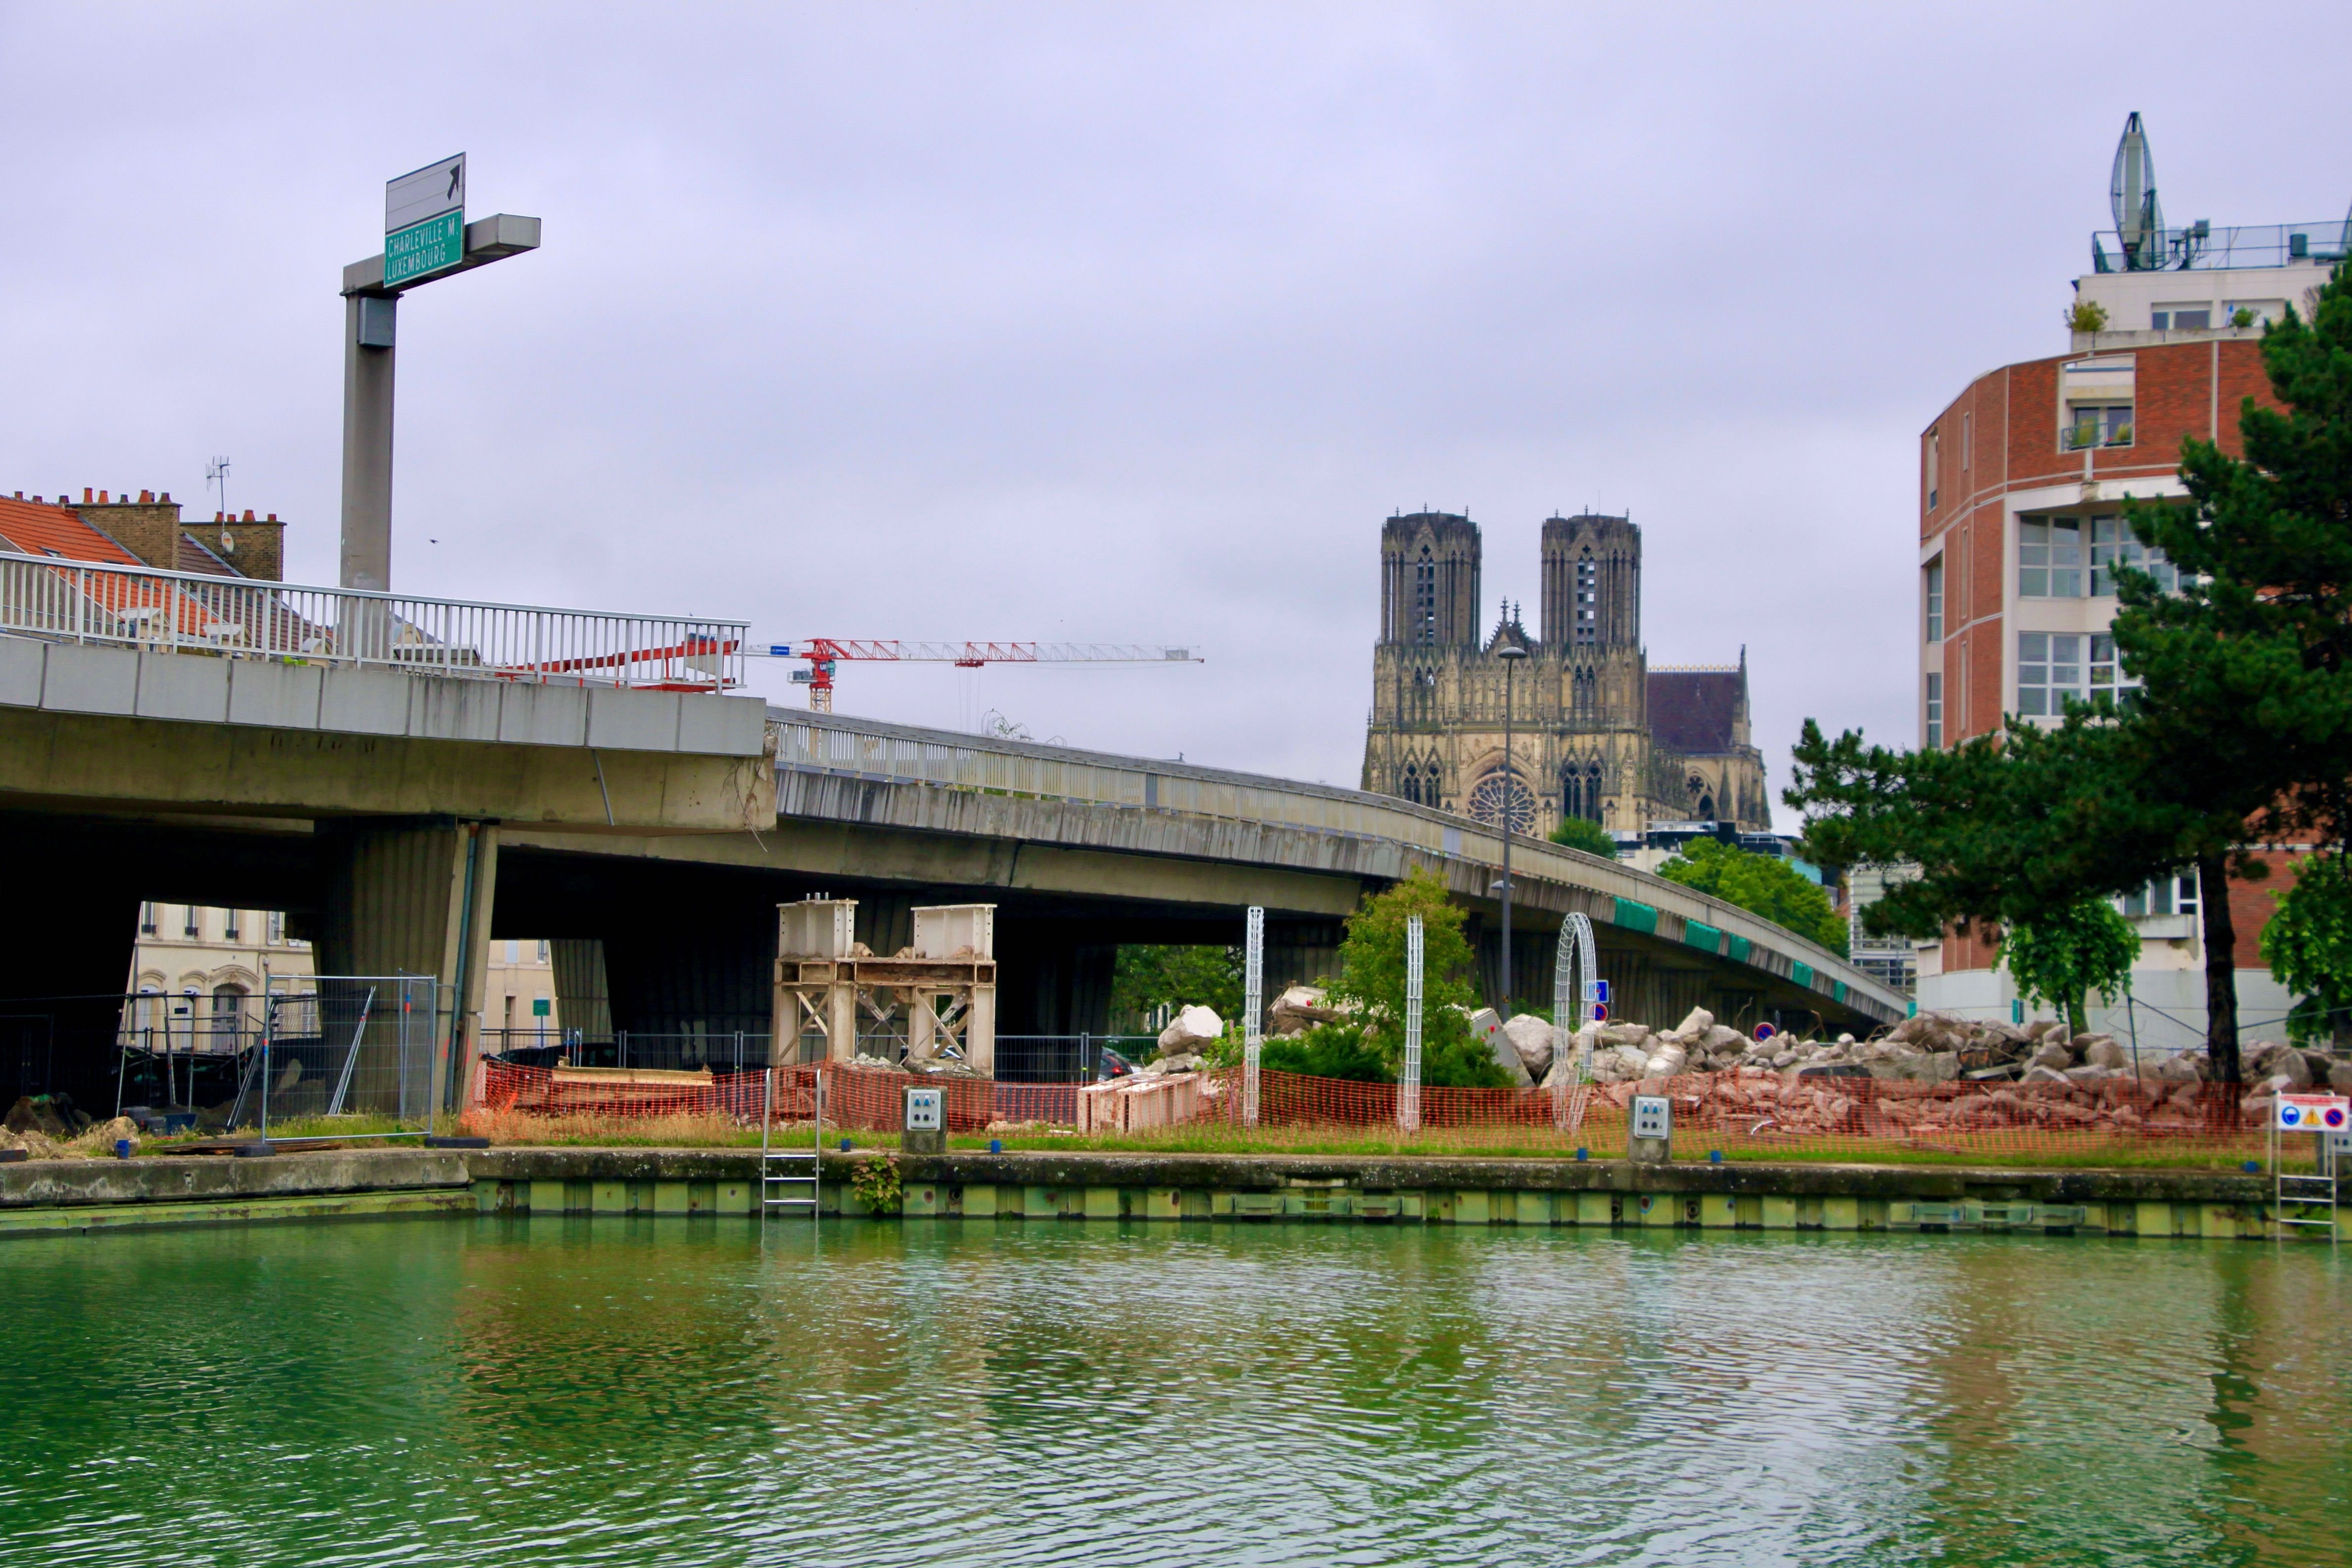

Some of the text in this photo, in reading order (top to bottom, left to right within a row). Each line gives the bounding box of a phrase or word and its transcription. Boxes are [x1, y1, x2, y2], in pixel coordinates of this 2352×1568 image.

[389, 217, 458, 257] CHARLEVILLE M.
[388, 243, 445, 280] LUXEMBOURG
